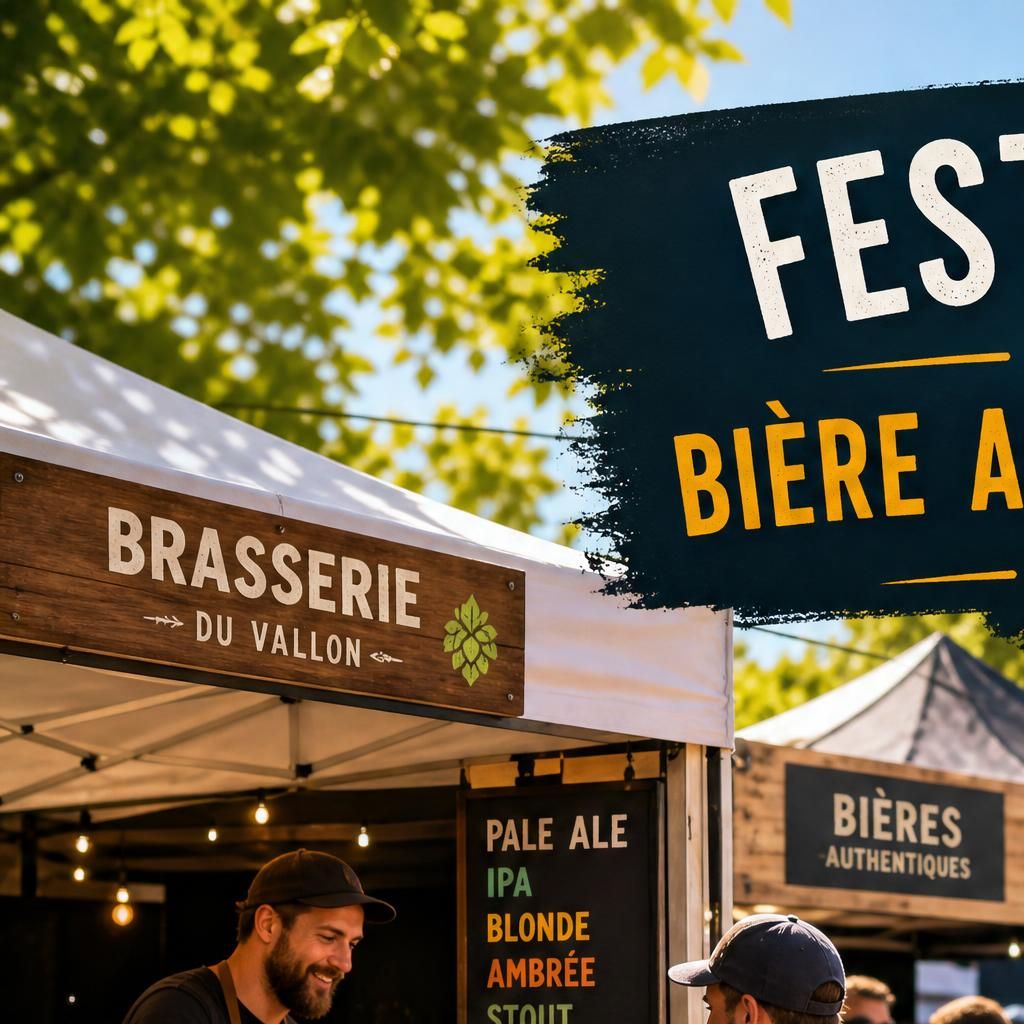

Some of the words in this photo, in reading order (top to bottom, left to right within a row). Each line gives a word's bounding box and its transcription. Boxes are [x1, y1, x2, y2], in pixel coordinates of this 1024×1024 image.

[107, 505, 421, 629] BRASSERIE
[195, 610, 233, 647] DU
[251, 620, 361, 668] VALLON
[486, 817, 554, 852] PALE
[568, 814, 628, 849] ALE
[832, 786, 963, 849] BIÈRES
[825, 844, 971, 881] AUTHENTIQUES
[487, 866, 533, 898] IPA
[487, 911, 590, 943] BLONDE
[486, 950, 596, 988] AMBRÉE
